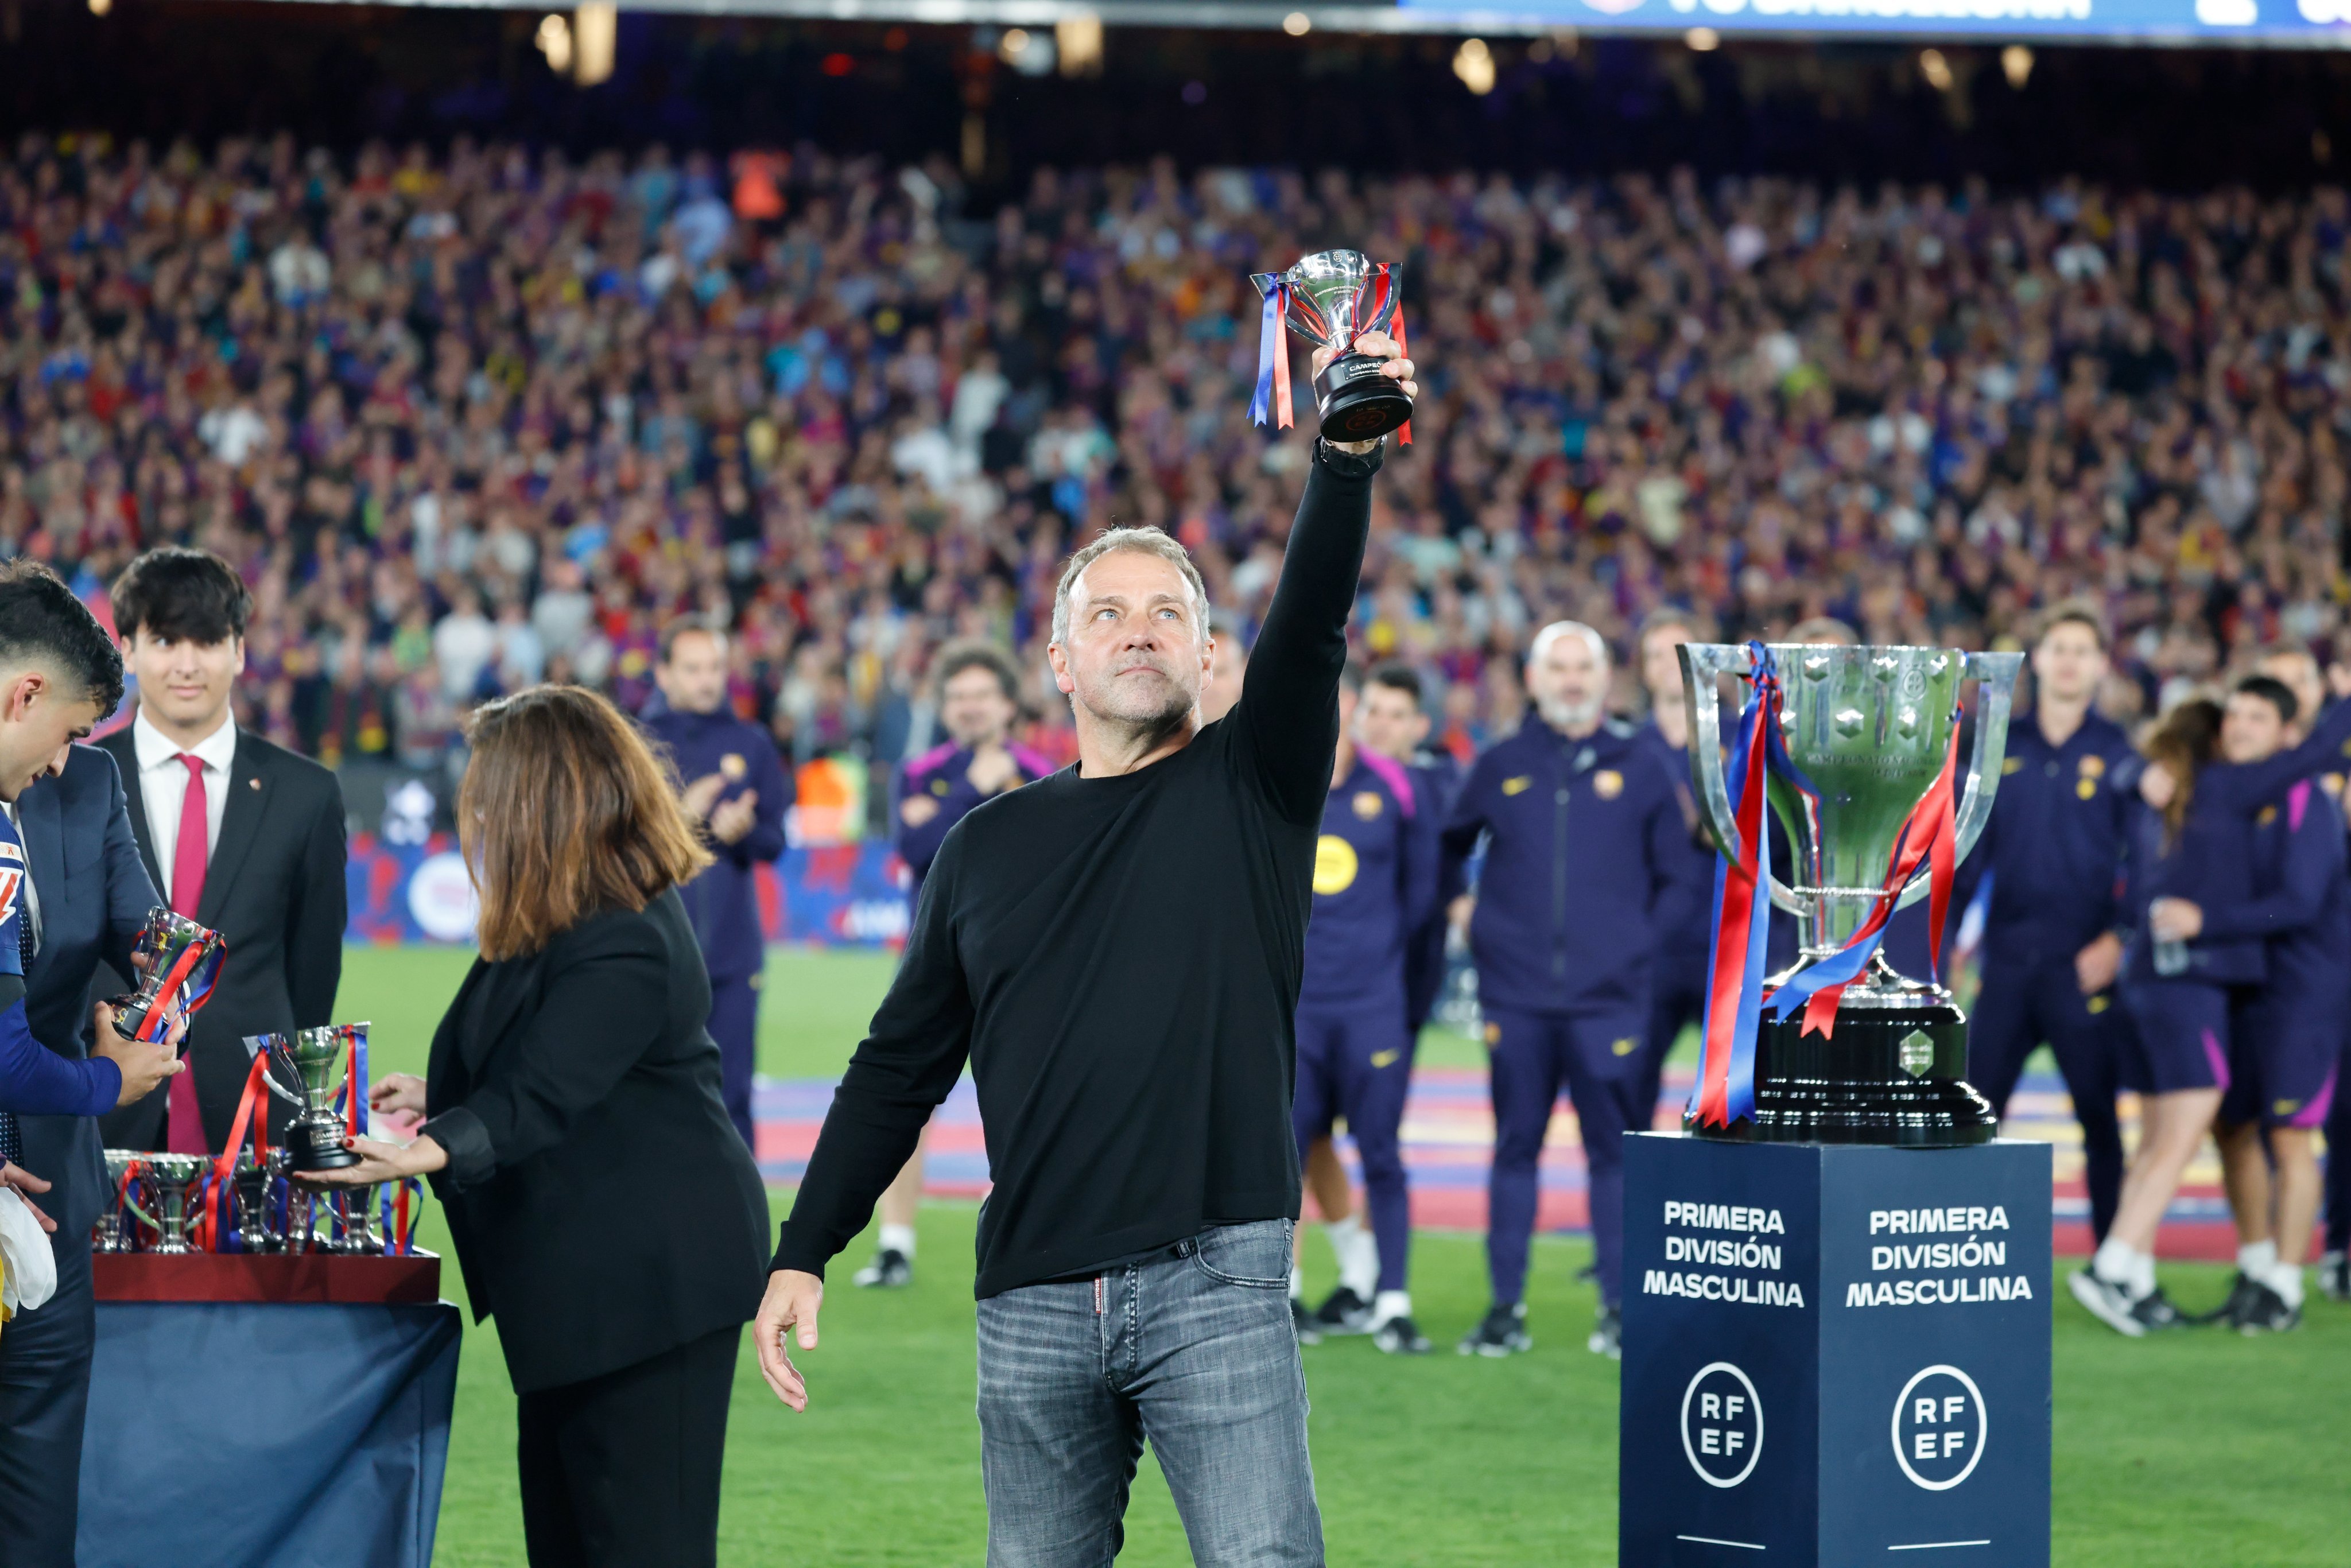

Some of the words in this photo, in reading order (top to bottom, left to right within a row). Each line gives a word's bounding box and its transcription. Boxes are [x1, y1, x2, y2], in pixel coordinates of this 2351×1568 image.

[1349, 362, 1383, 371] CAMPEÓ
[1665, 1201, 1785, 1235] PRIMERA
[1869, 1206, 2010, 1235] PRIMERA
[1666, 1236, 1781, 1270] DIVISIÓN
[1872, 1234, 2005, 1271] DIVISIÓN
[1643, 1270, 1805, 1309] MASCULINA
[1845, 1275, 2033, 1308] MASCULINA
